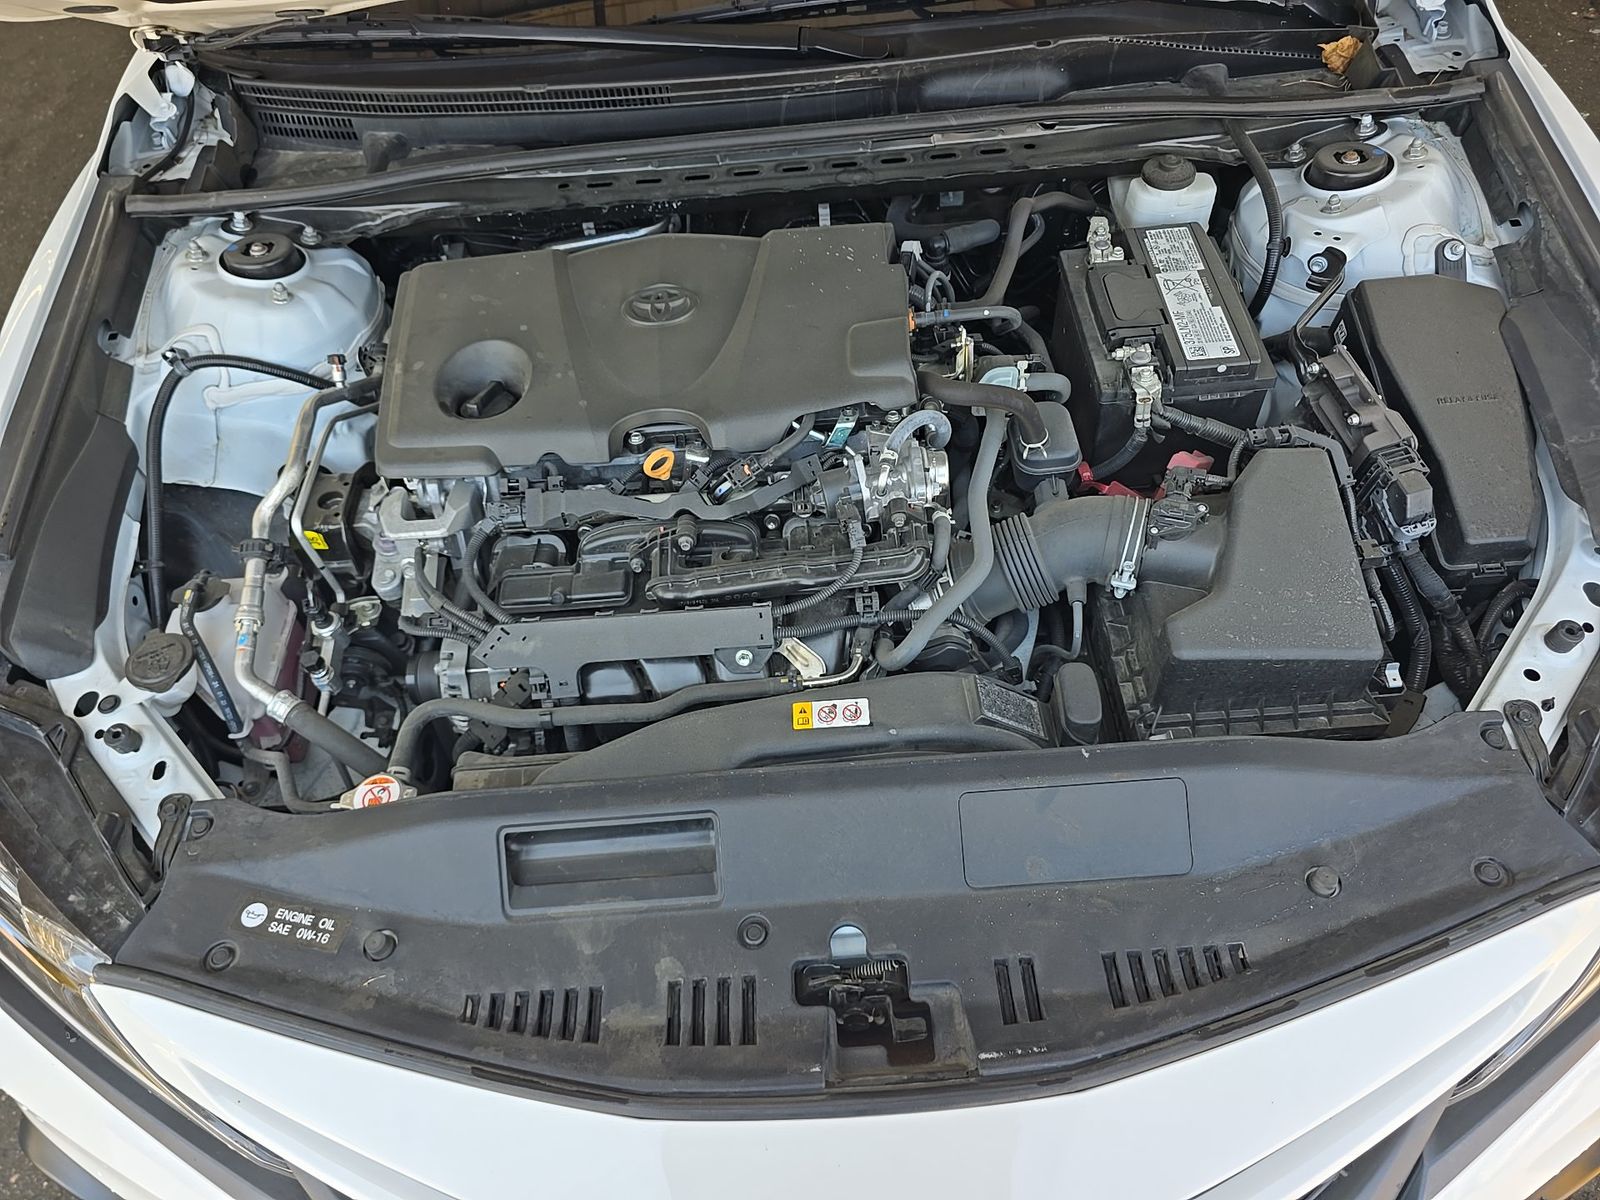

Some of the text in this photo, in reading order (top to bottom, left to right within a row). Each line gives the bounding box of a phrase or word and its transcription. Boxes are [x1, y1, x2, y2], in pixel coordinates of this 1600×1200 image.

[275, 908, 335, 931] ENGINE OIL
[268, 921, 330, 944] SAE 0W-16
